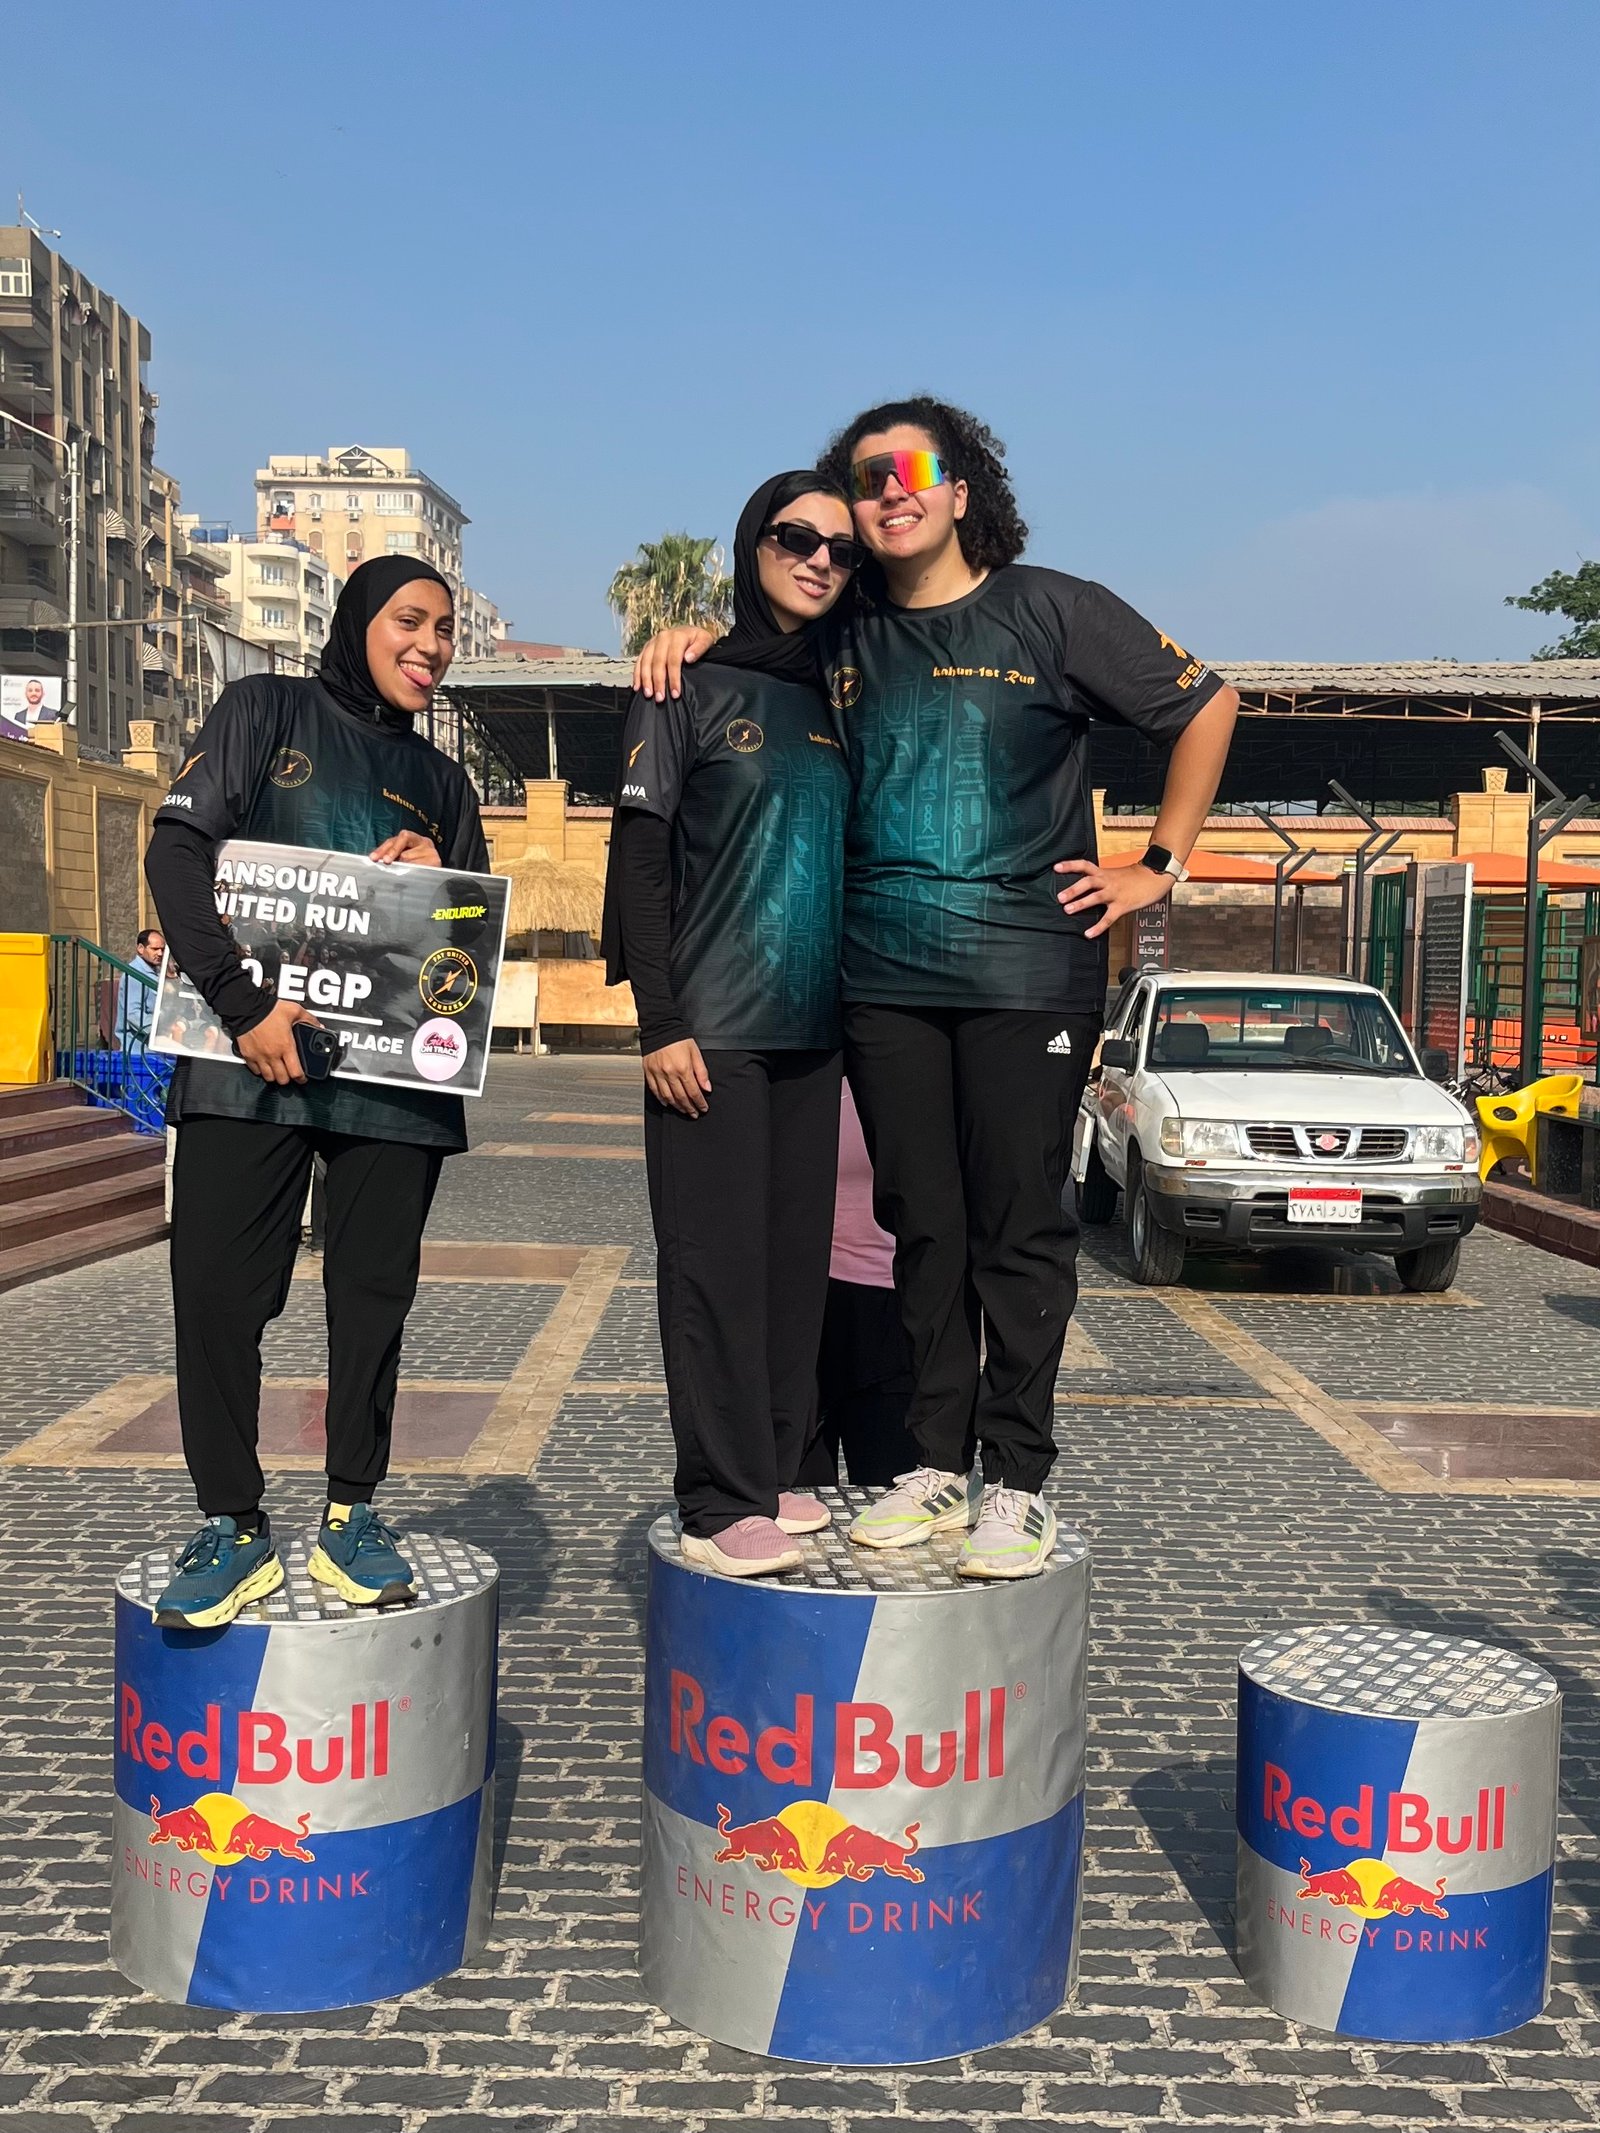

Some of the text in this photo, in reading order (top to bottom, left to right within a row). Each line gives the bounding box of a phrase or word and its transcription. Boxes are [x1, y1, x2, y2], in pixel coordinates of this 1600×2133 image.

[1004, 670, 1035, 685] Run
[621, 783, 647, 799] AVA
[214, 860, 360, 900] ANSOURA
[213, 891, 371, 936] NITED RUN
[1138, 932, 1165, 944] فحص
[1138, 945, 1165, 957] مركبة
[277, 963, 373, 1009] EGP
[339, 1030, 405, 1055] PLACE
[1046, 1045, 1071, 1055] adidas
[120, 1681, 390, 1784] Red Bull
[669, 1668, 1006, 1790] Red Bull
[1263, 1760, 1506, 1855] Red Bull
[125, 1847, 371, 1904] ENERGY DRINK
[677, 1865, 984, 1934] ENERGY DRINK
[1267, 1897, 1489, 1952] ENERGY DRINK
